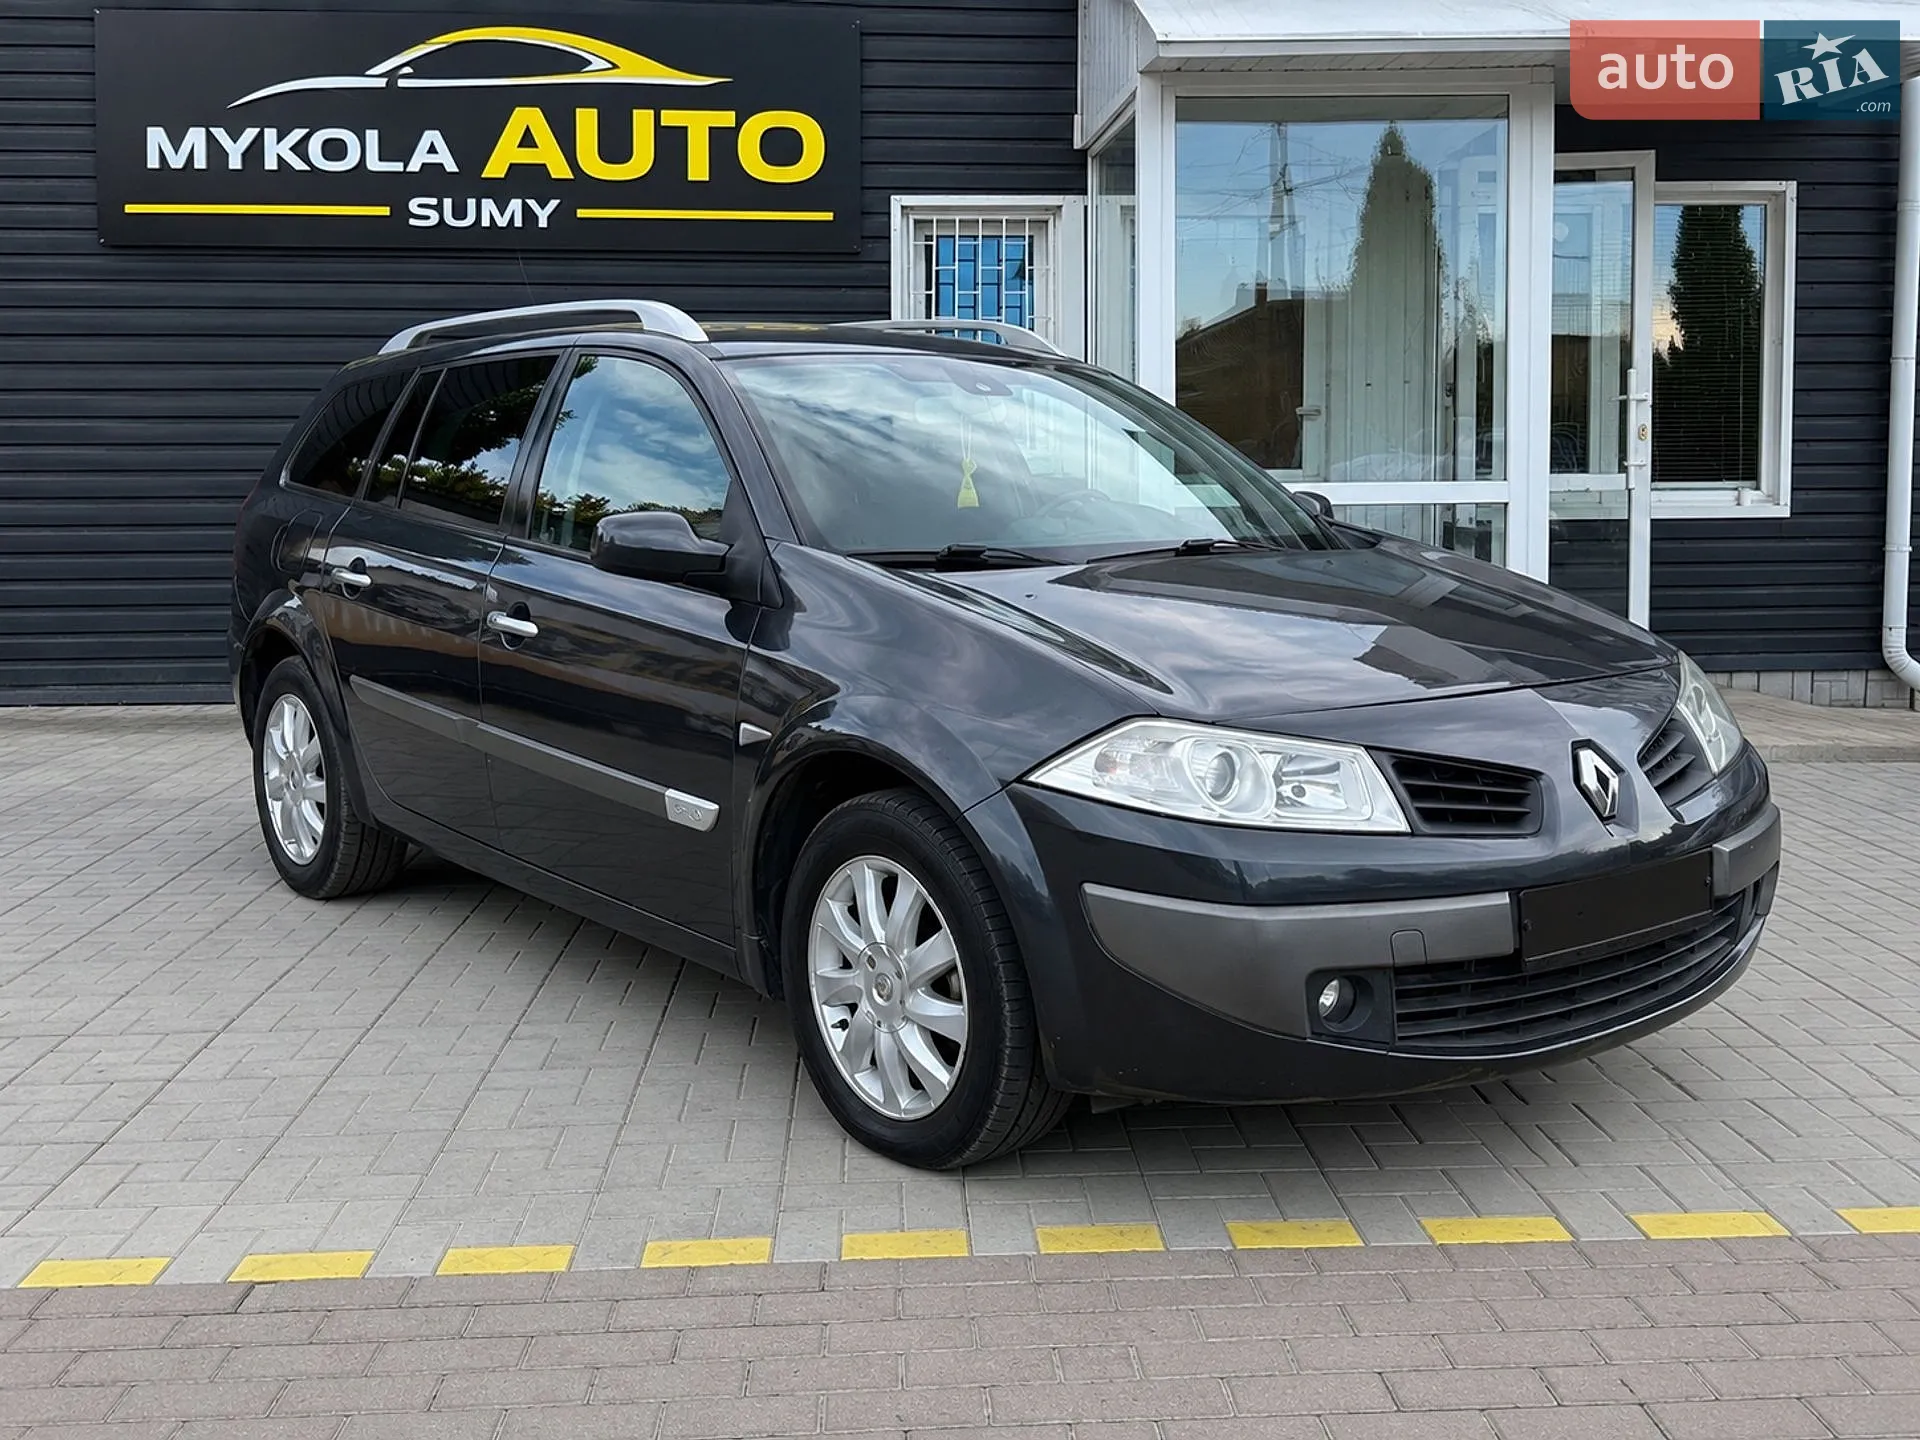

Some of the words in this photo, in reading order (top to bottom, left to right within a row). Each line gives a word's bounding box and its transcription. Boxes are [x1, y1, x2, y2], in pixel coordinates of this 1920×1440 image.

[146, 127, 460, 173] MYKOLA
[481, 107, 826, 183] AUTO
[408, 197, 561, 228] SUMY
